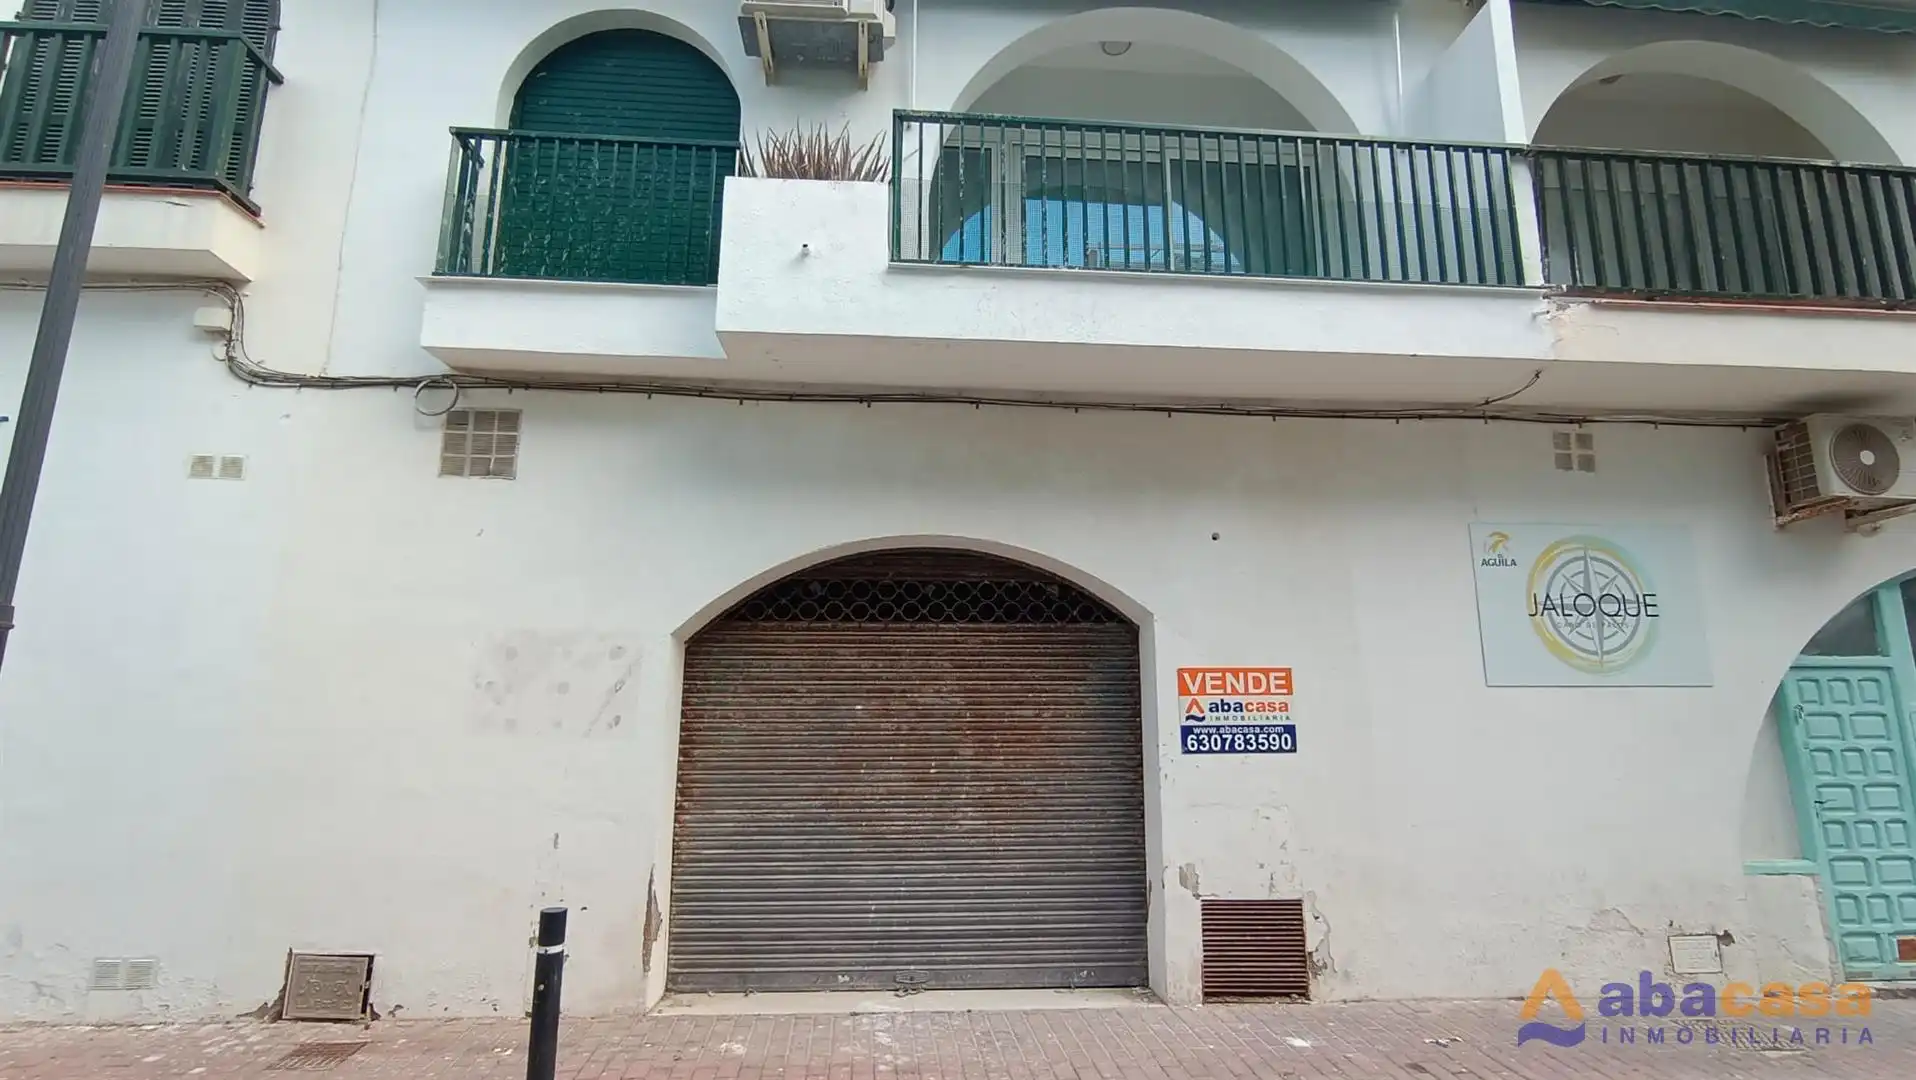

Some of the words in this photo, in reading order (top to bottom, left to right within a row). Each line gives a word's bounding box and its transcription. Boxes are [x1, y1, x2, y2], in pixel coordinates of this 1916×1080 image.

[1528, 593, 1660, 617] JALOQUE
[1182, 672, 1289, 694] VENDE
[1208, 698, 1289, 713] abacasa
[1193, 726, 1284, 734] www.abacasa.com
[1187, 734, 1292, 751] 630783590
